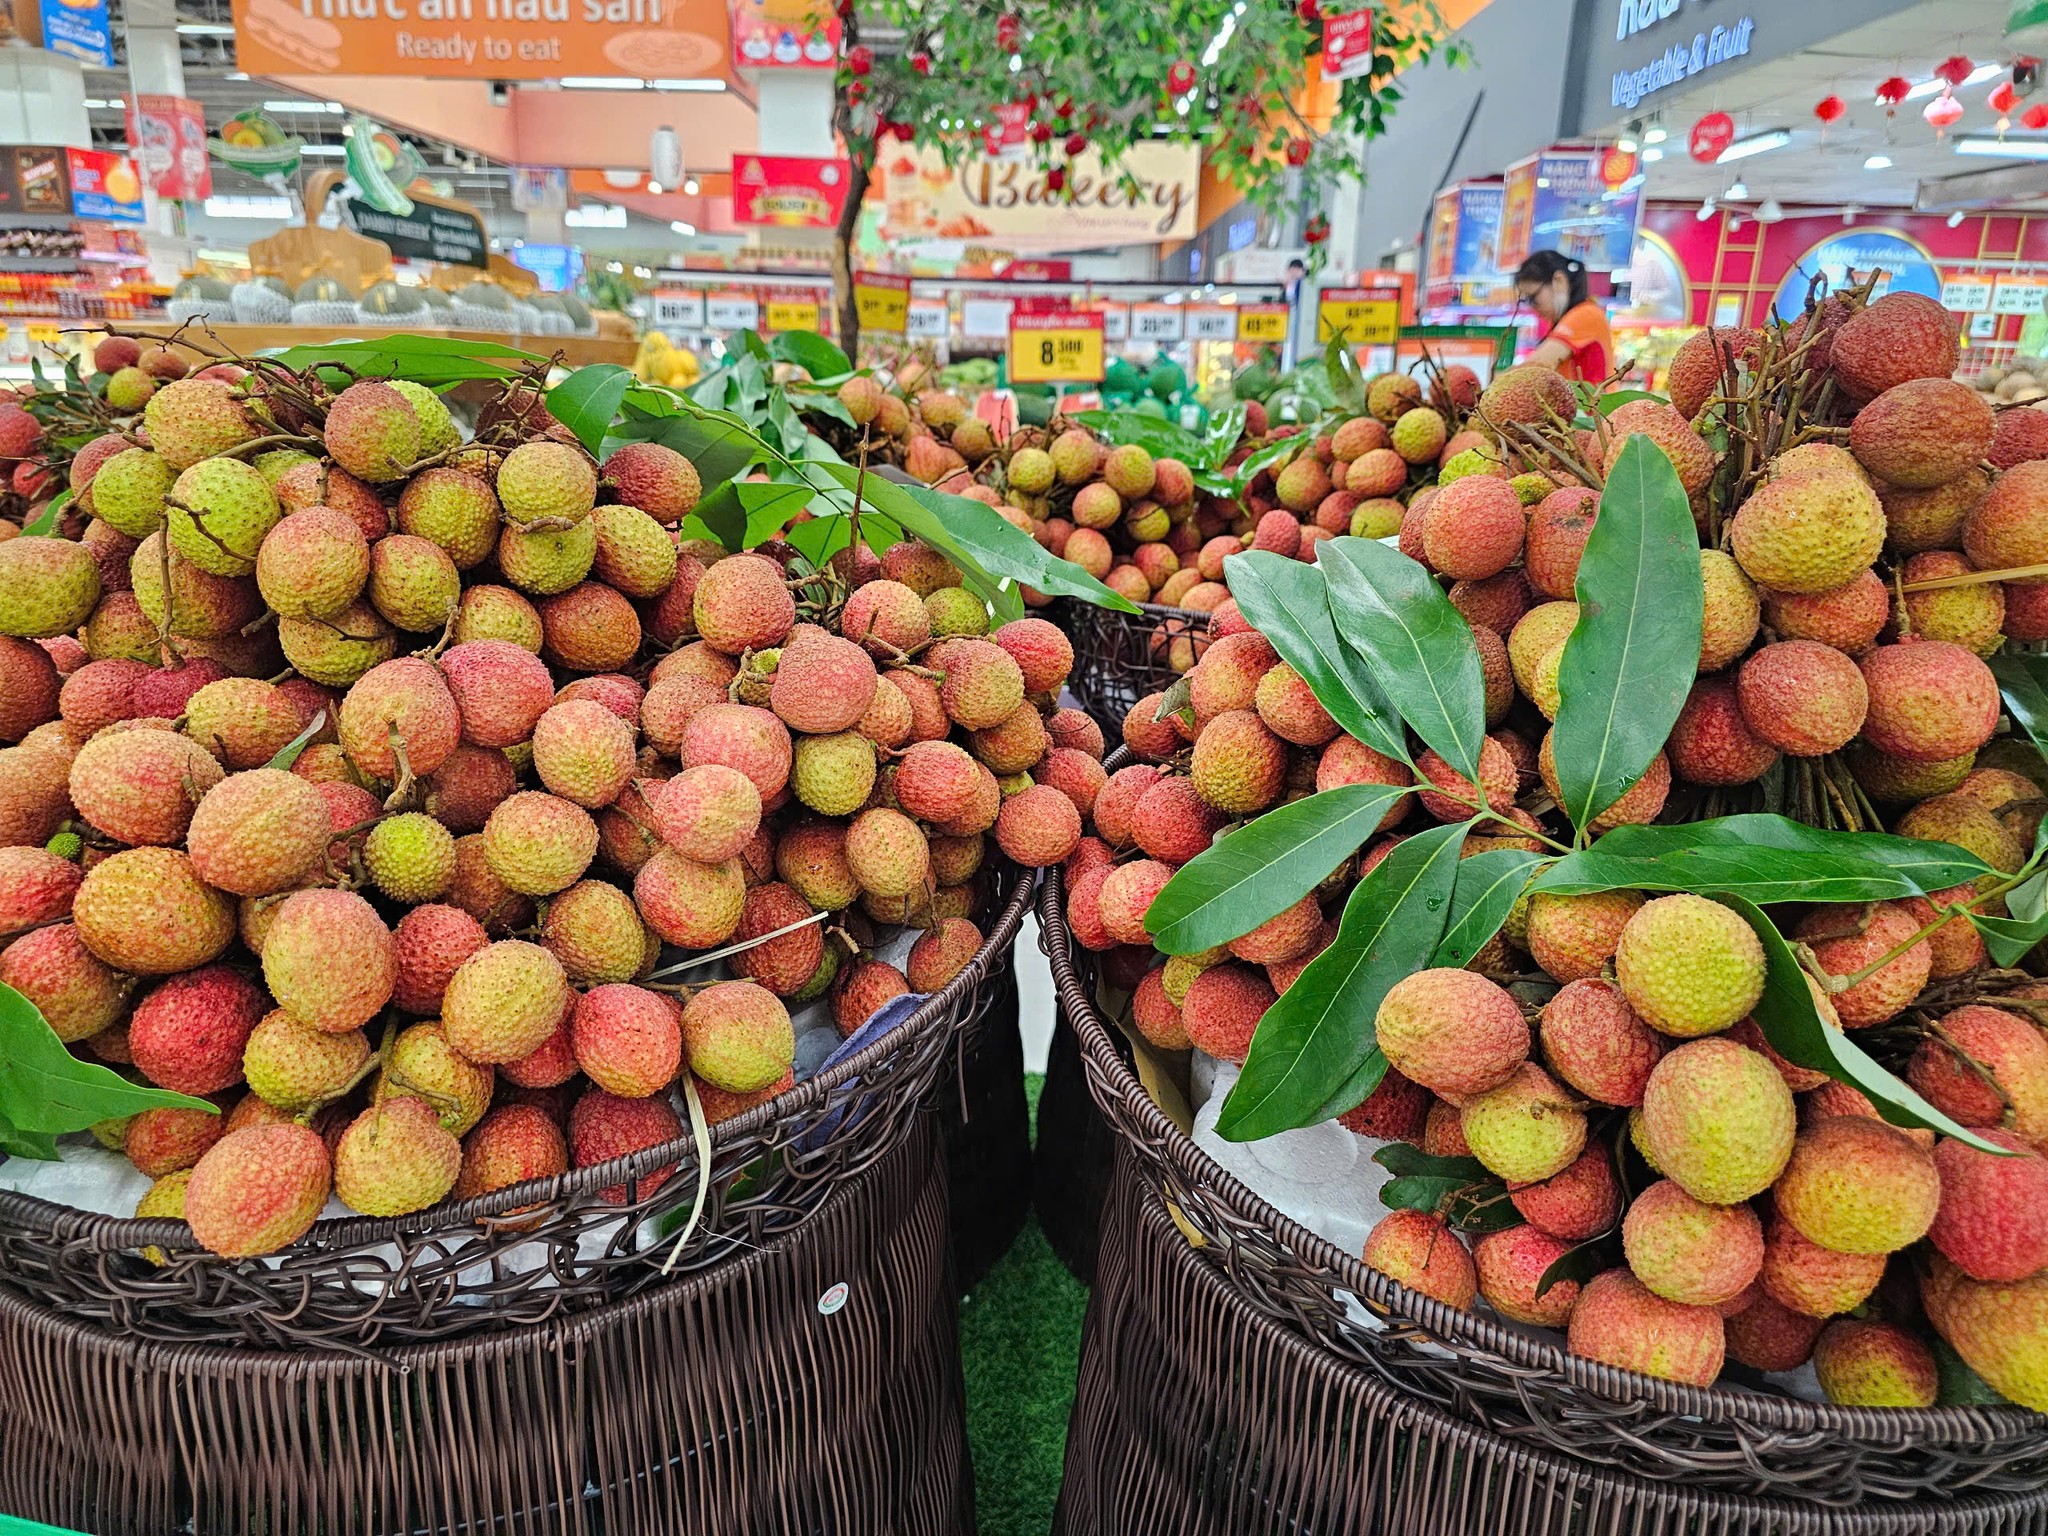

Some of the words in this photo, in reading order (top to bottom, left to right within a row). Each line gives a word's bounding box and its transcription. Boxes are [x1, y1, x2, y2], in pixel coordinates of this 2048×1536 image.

[396, 31, 477, 65] Ready
[483, 34, 513, 61] to
[517, 35, 562, 62] eat
[1611, 42, 1690, 109] Vegetable
[1687, 32, 1707, 76] &
[1706, 16, 1755, 67] Fruit
[1041, 340, 1054, 366] 8
